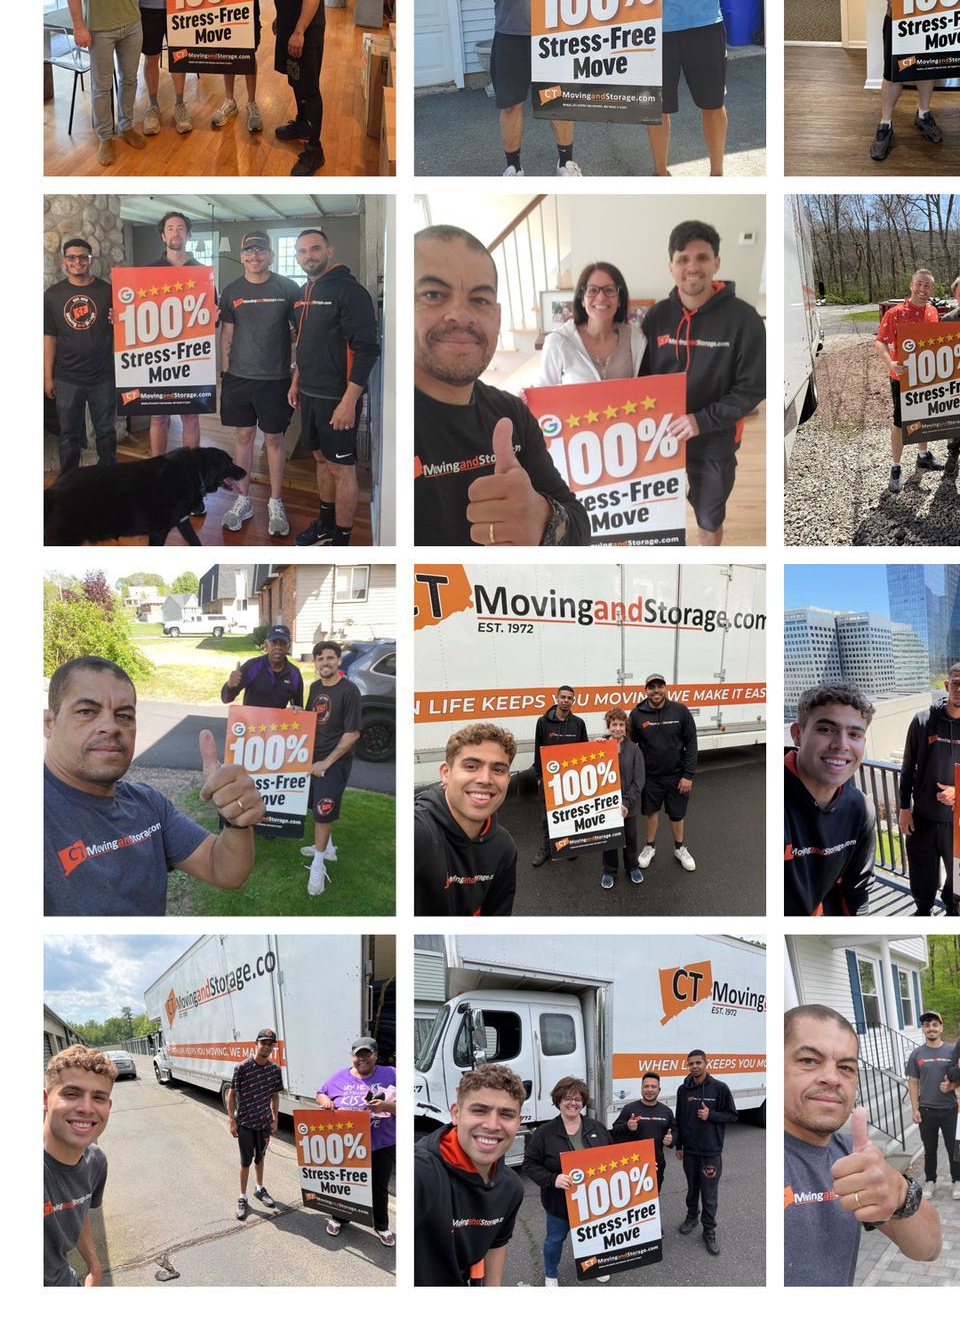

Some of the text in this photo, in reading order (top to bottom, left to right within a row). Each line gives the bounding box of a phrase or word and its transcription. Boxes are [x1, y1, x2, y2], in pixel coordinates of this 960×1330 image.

[172, 6, 250, 30] Stress-Free
[539, 27, 656, 59] Stress-Free
[573, 54, 628, 80] Move
[545, 89, 656, 103] CT MovingandStorage.com
[118, 293, 210, 346] 100%
[121, 340, 211, 369] Stress-Free
[149, 363, 191, 384] Move
[140, 391, 211, 400] MovingandStorage.com
[549, 413, 678, 486] 100%
[592, 506, 650, 533] Move
[478, 622, 534, 634] EST. 1972
[429, 688, 742, 715] LIFE KEEPS MOVIN WE MAKE IT
[230, 734, 308, 771] 100%
[549, 759, 617, 806] 100%
[552, 794, 619, 825] Stress-Free
[672, 968, 766, 1014] CT Moving
[711, 1006, 737, 1017] EST. 1972
[230, 1046, 240, 1058] WE
[638, 1058, 755, 1071] WHEN KEEPS YOU
[299, 1133, 367, 1165] 100%
[302, 1167, 368, 1182] Stress-Free
[572, 1163, 654, 1222] 100%
[577, 1203, 656, 1243] Stress-Free
[604, 1226, 640, 1251] Move
